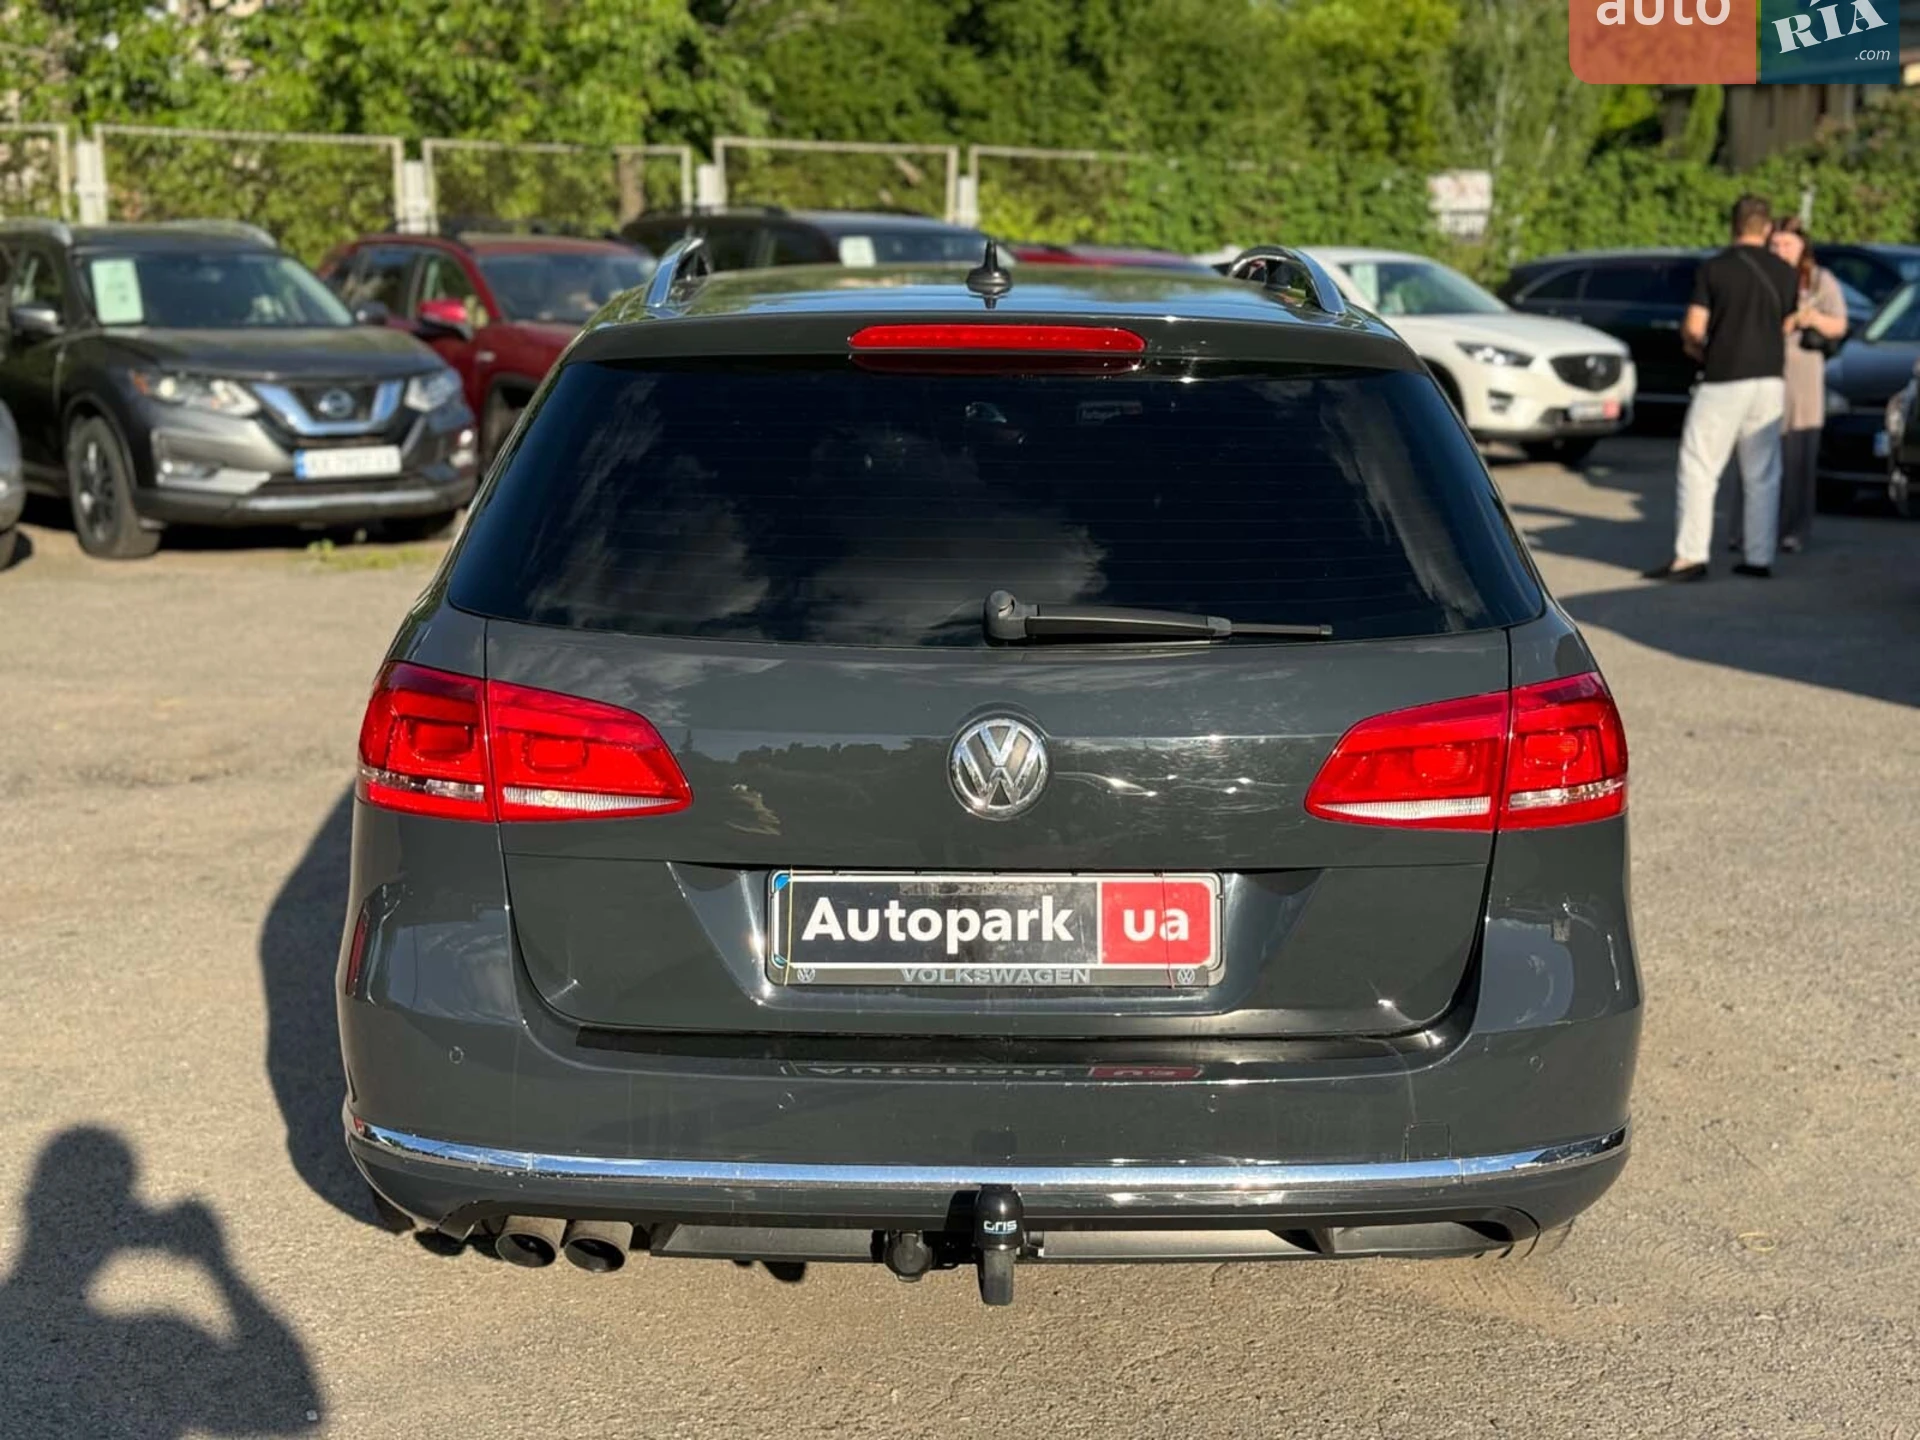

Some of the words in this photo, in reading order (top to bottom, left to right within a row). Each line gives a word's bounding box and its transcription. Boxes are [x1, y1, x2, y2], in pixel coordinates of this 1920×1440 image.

[801, 895, 1075, 955] Autopark
[1123, 908, 1189, 941] ua
[901, 968, 1090, 984] VOLKSWAGEN
